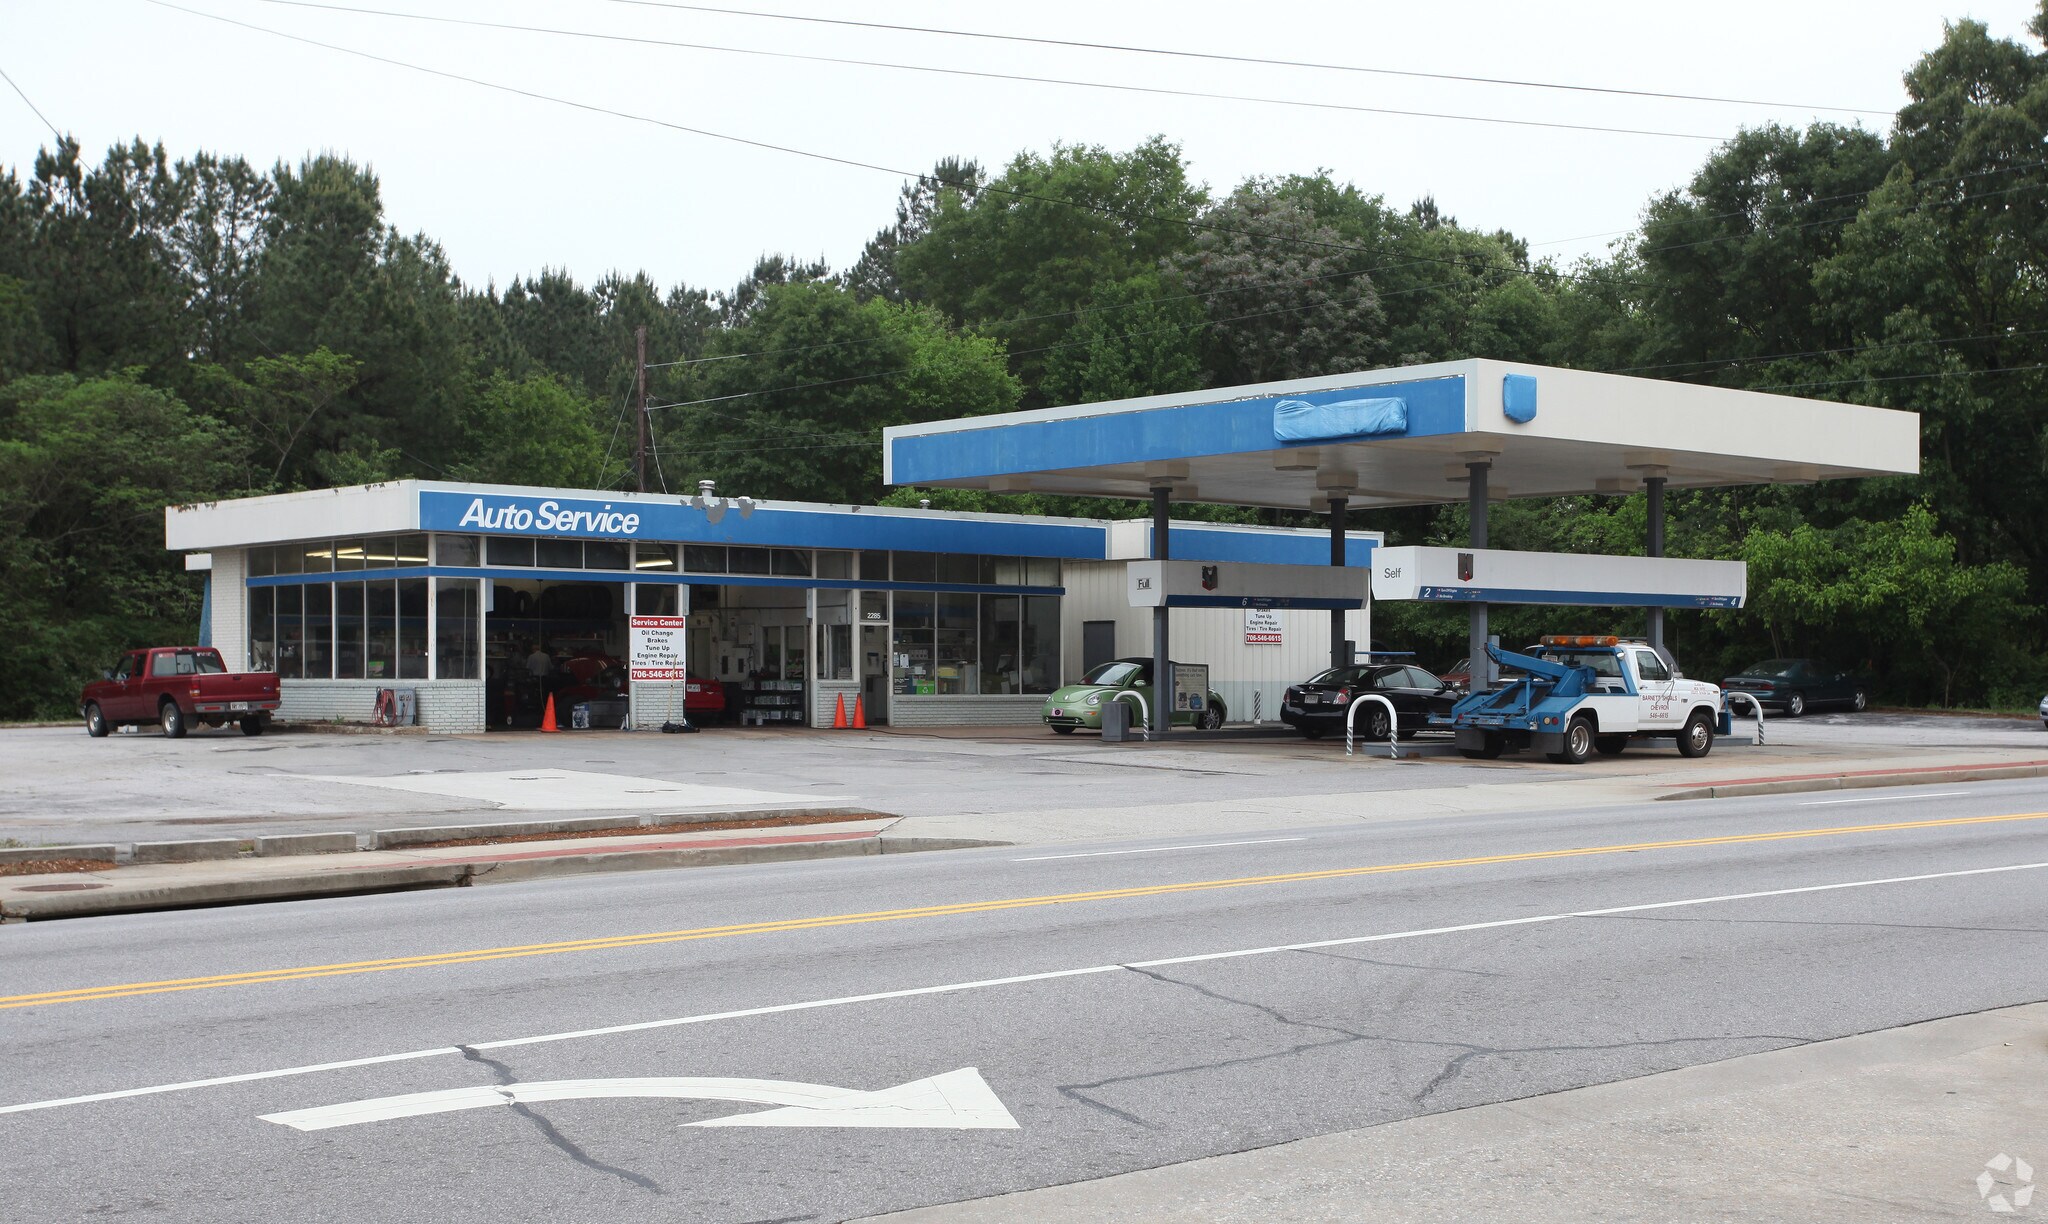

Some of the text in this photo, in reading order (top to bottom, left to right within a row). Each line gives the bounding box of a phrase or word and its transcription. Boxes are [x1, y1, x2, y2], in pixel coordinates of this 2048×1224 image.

[459, 498, 640, 534] Auto Service
[1384, 567, 1401, 579] Self
[1138, 579, 1150, 588] Full
[1424, 587, 1431, 598] 2
[1242, 598, 1248, 606] 6
[1730, 598, 1736, 606] 4
